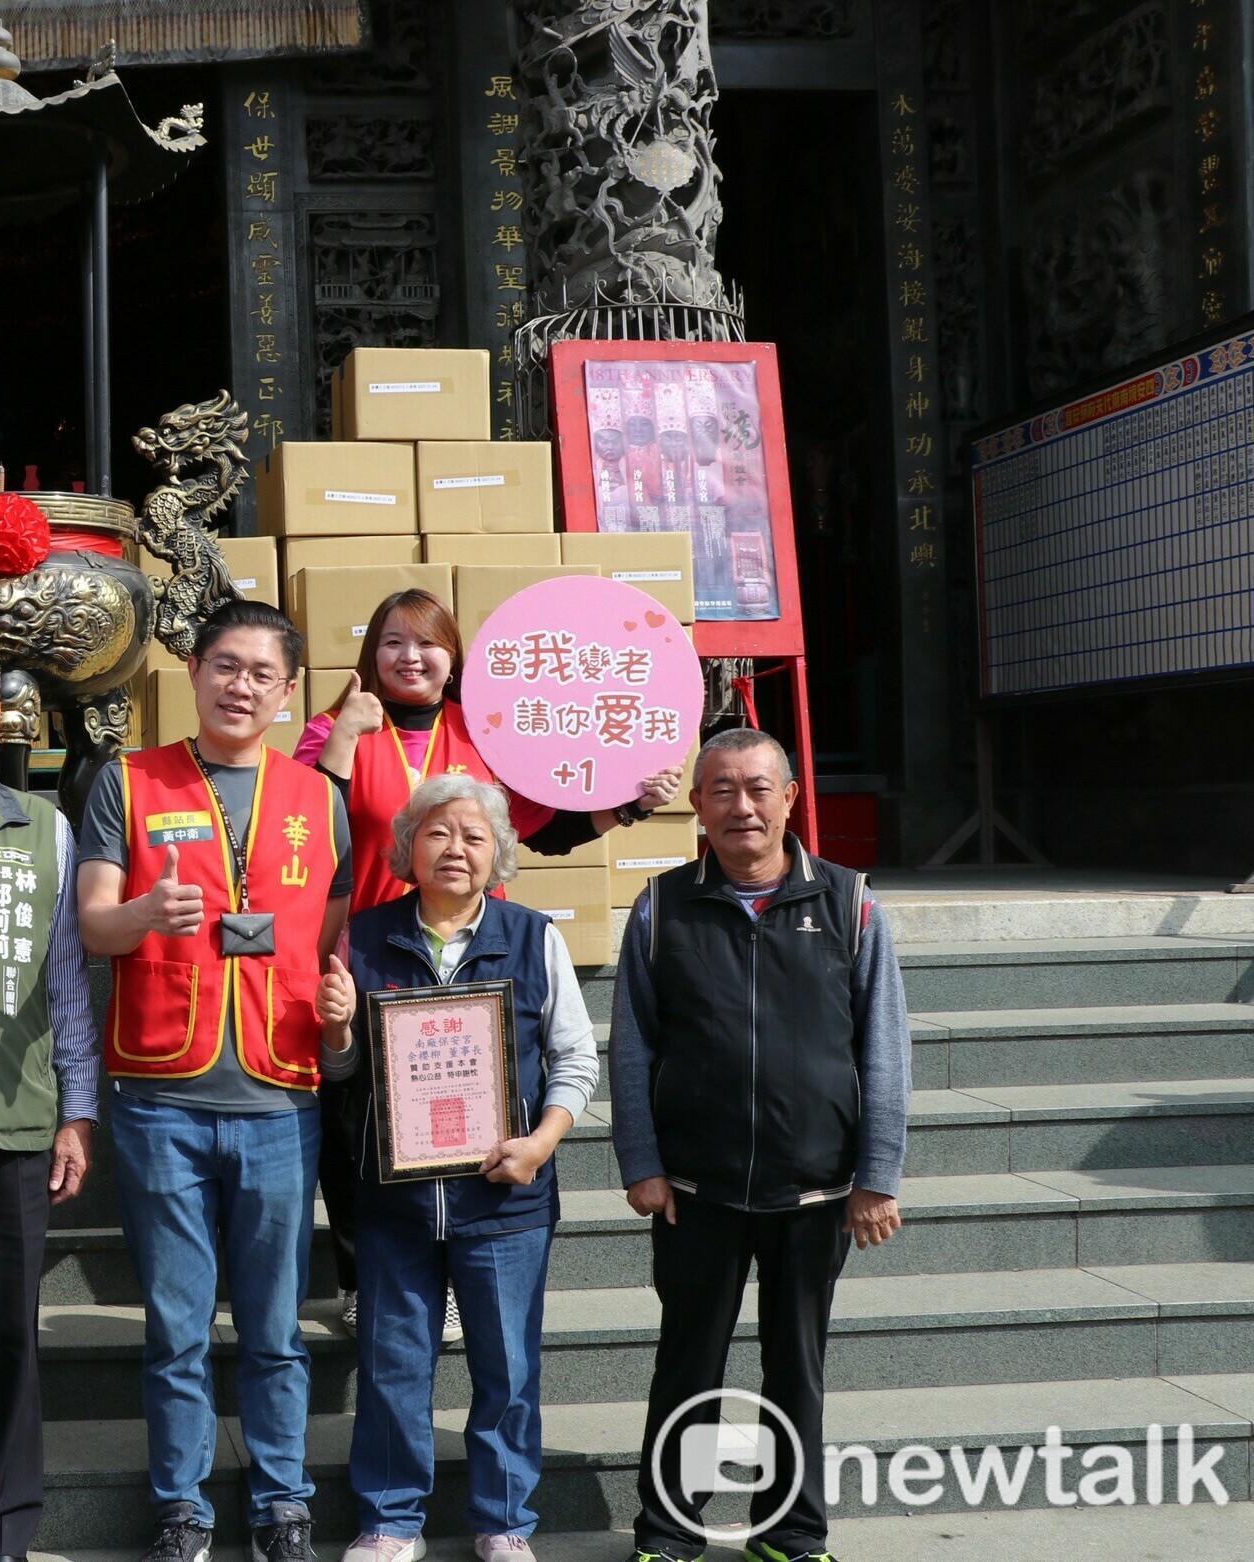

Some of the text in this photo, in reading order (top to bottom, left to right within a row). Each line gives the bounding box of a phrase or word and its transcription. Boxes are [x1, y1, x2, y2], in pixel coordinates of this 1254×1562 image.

[487, 632, 651, 685] 當我變老
[515, 694, 679, 745] 請你愛我
[553, 759, 596, 793] +1
[162, 828, 199, 842] 黃中衛
[2, 850, 30, 862] DPP
[281, 814, 311, 888] 華山
[14, 868, 37, 963] 林俊憲
[5, 966, 17, 1015] 聯合團隊
[420, 1017, 463, 1037] 感謝
[415, 1034, 472, 1050] 南廠保安宮
[449, 1044, 482, 1059] 董事長
[411, 1072, 442, 1082] 熱心公益
